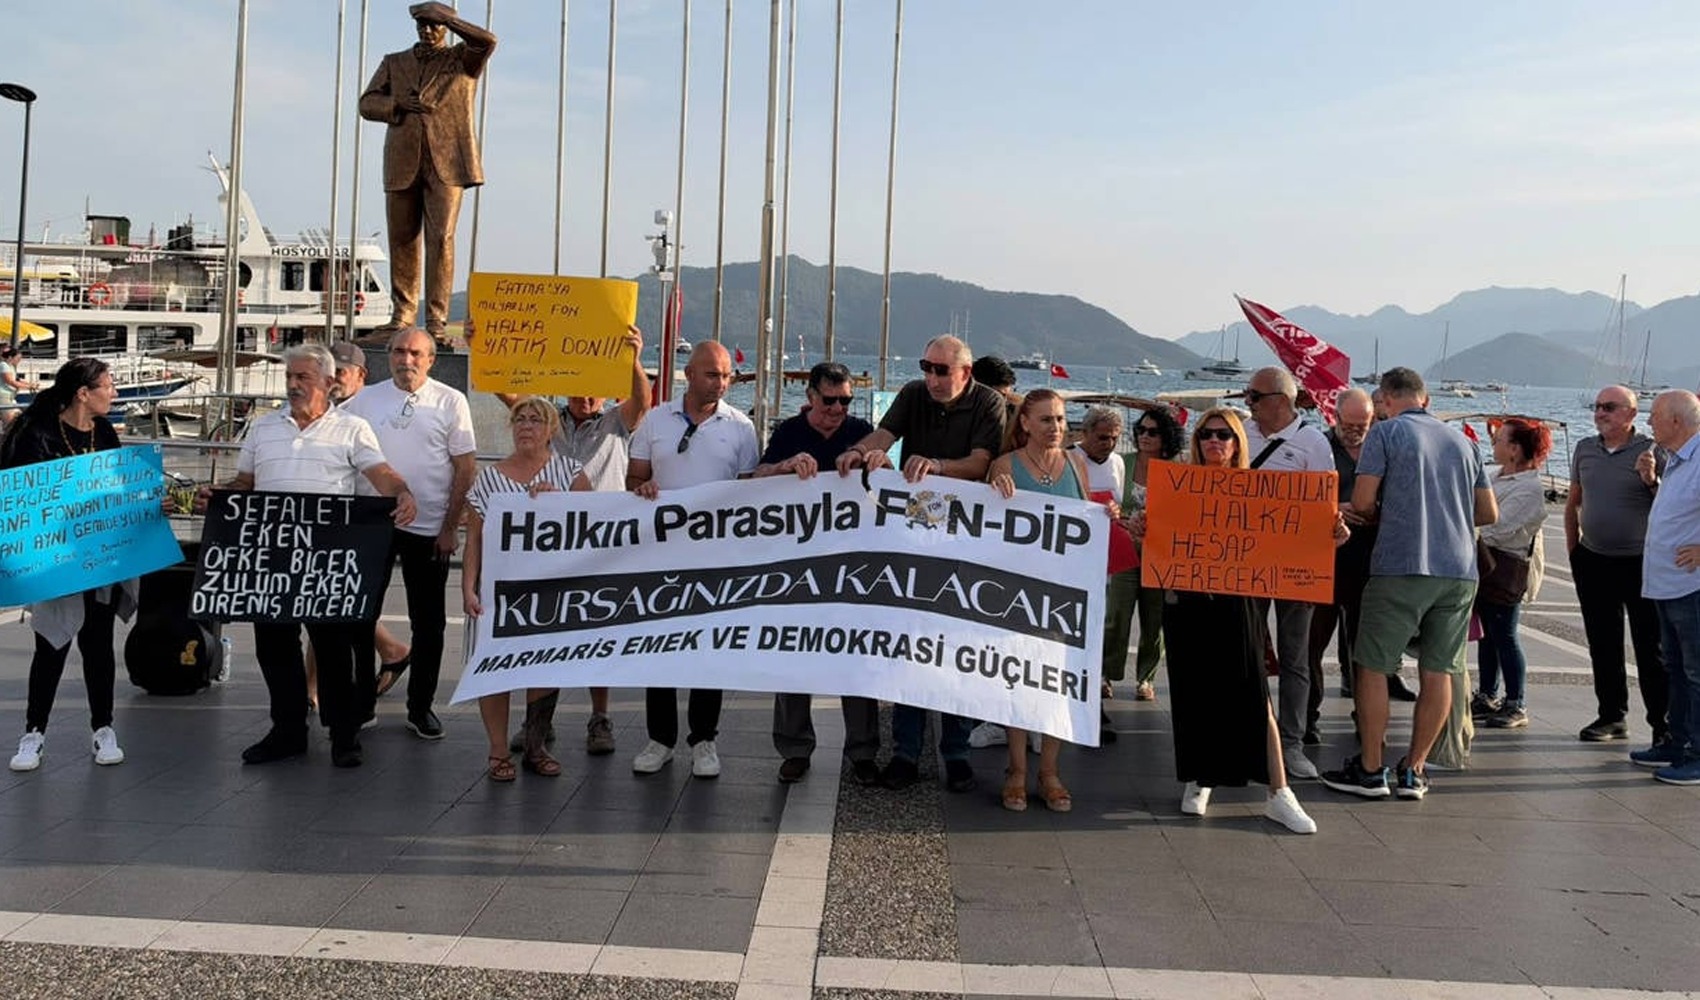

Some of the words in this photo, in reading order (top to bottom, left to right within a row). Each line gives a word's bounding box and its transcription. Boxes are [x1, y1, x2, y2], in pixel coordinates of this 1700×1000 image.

[551, 304, 580, 317] FON
[486, 319, 544, 334] HALKA
[484, 336, 548, 363] YIRTIK
[41, 499, 100, 525] FONDAN
[224, 494, 354, 525] SEFALET
[500, 511, 640, 552] Halkın
[654, 492, 860, 544] Parasıyla
[1200, 500, 1301, 534] HALKA
[34, 530, 68, 549] AYNI
[239, 522, 312, 548] EKEN
[1172, 532, 1256, 562] HESAP
[204, 541, 270, 571] ÖFKE
[301, 574, 362, 596] EKEN
[1150, 562, 1278, 594] VERECEK!!
[498, 568, 820, 627] KURSAĞINIZDA
[834, 564, 1084, 638] KALACAK!
[473, 638, 616, 676] MARMARİS
[620, 629, 704, 656] EMEK
[712, 626, 750, 650] VE
[757, 625, 945, 667] DEMOKRASİ
[955, 644, 1088, 702] GÜÇLERİ
